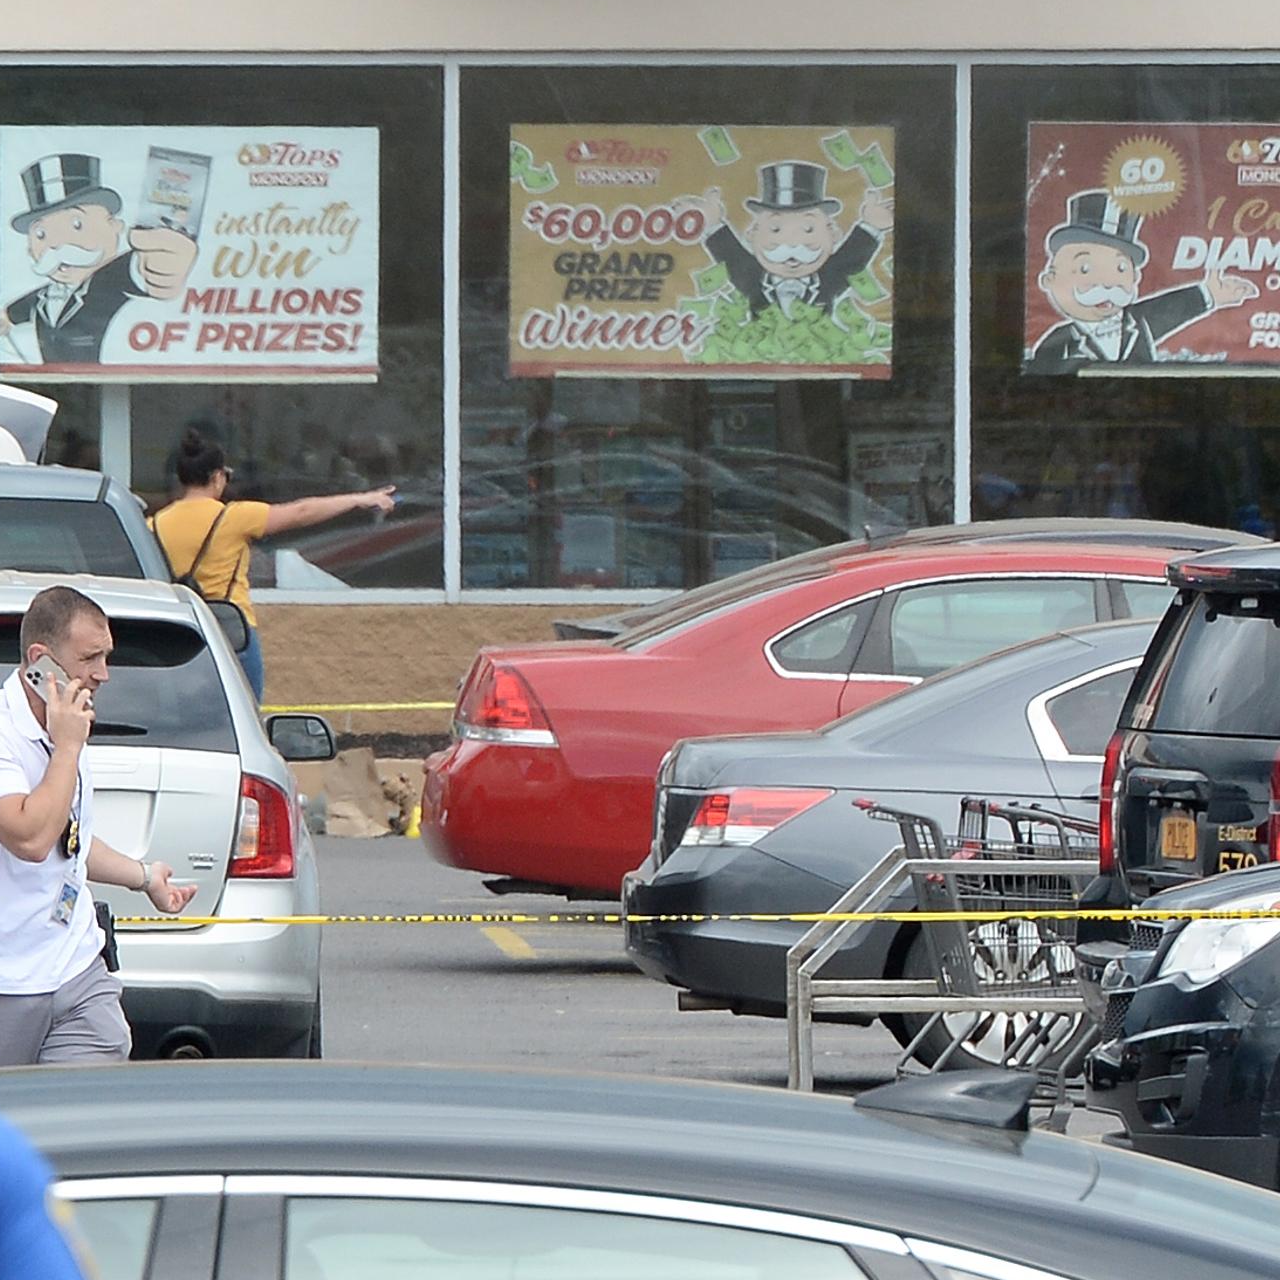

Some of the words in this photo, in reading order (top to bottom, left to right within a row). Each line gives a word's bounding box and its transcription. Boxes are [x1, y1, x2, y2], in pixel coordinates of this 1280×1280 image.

[1120, 156, 1165, 184] 60
[215, 201, 360, 255] instantly
[528, 205, 705, 246] $60,000
[554, 251, 674, 276] GRAND
[181, 287, 364, 315] MILLIONS
[564, 277, 665, 301] PRIZE
[128, 322, 189, 352] OF
[195, 322, 363, 353] PRIZES!
